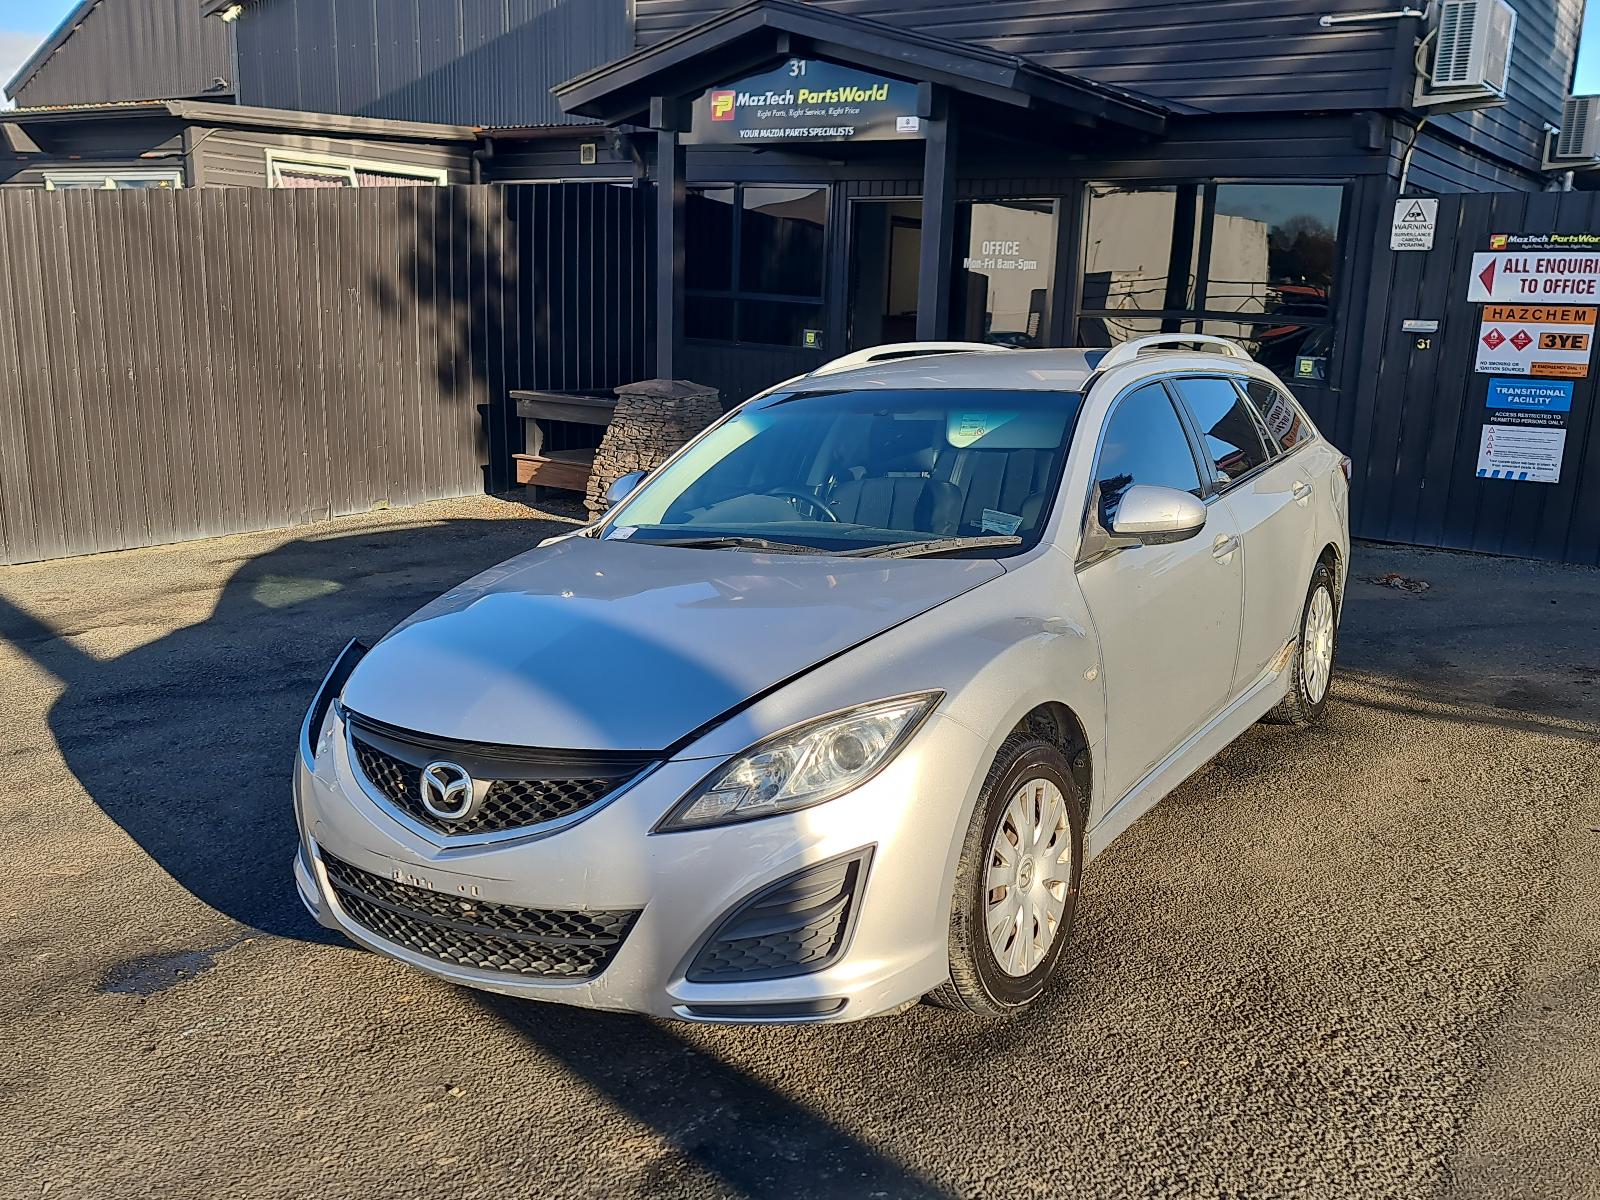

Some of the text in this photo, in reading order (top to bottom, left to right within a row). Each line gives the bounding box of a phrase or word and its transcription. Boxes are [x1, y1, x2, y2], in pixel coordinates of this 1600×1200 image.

[789, 58, 807, 76] 31
[736, 83, 889, 107] MazTech PartsWorld
[757, 109, 771, 119] Right
[788, 108, 803, 118] Right
[828, 106, 843, 117] Right
[844, 106, 861, 115] Price
[740, 126, 855, 138] YOUR MAZDA PARTS SPECIALISTS
[1508, 234, 1549, 243] MazTech
[982, 241, 1020, 255] OFFICE
[963, 257, 1037, 271] Mon-Fri 8am-5pm
[1503, 258, 1600, 275] ALL ENQUIRI
[1520, 278, 1597, 295] TO OFFICE
[1492, 308, 1587, 321] HAZCHEM
[1416, 338, 1431, 349] 31
[1543, 334, 1583, 349] 3YE
[1496, 387, 1566, 397] TRANSITIONAL
[1507, 396, 1552, 404] FACILITY
